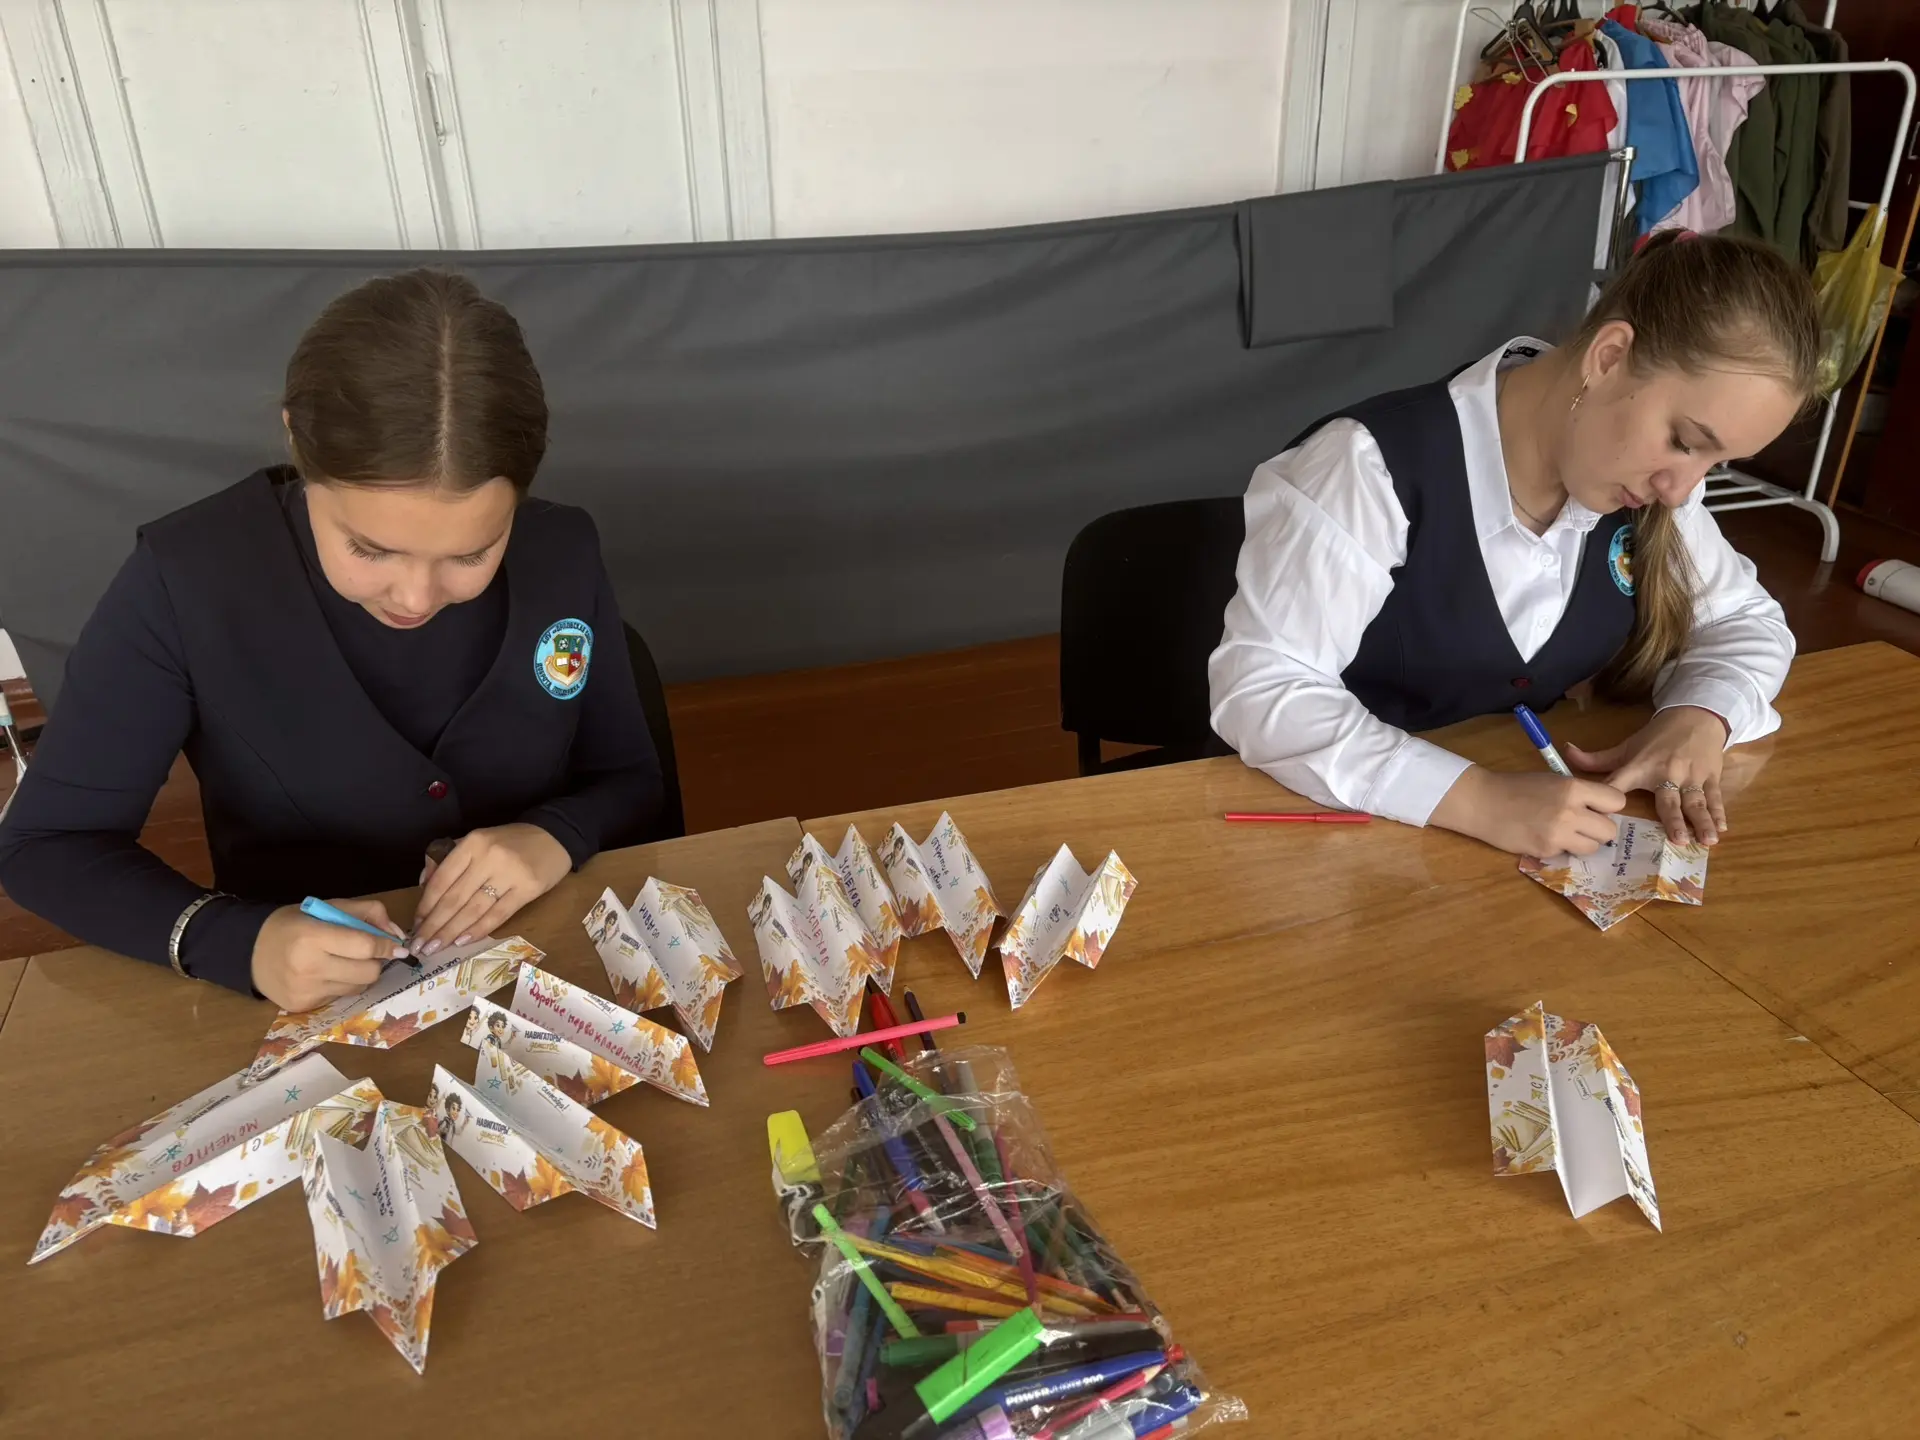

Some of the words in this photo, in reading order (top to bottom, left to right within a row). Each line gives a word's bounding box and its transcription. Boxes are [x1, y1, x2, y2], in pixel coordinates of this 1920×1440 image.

[838, 856, 862, 909] УСПЕХОВ
[529, 981, 567, 1020] Дорогие
[524, 1029, 562, 1043] НАВИГАТОРЫ
[476, 1117, 510, 1134] НАВИГАТОРЫ
